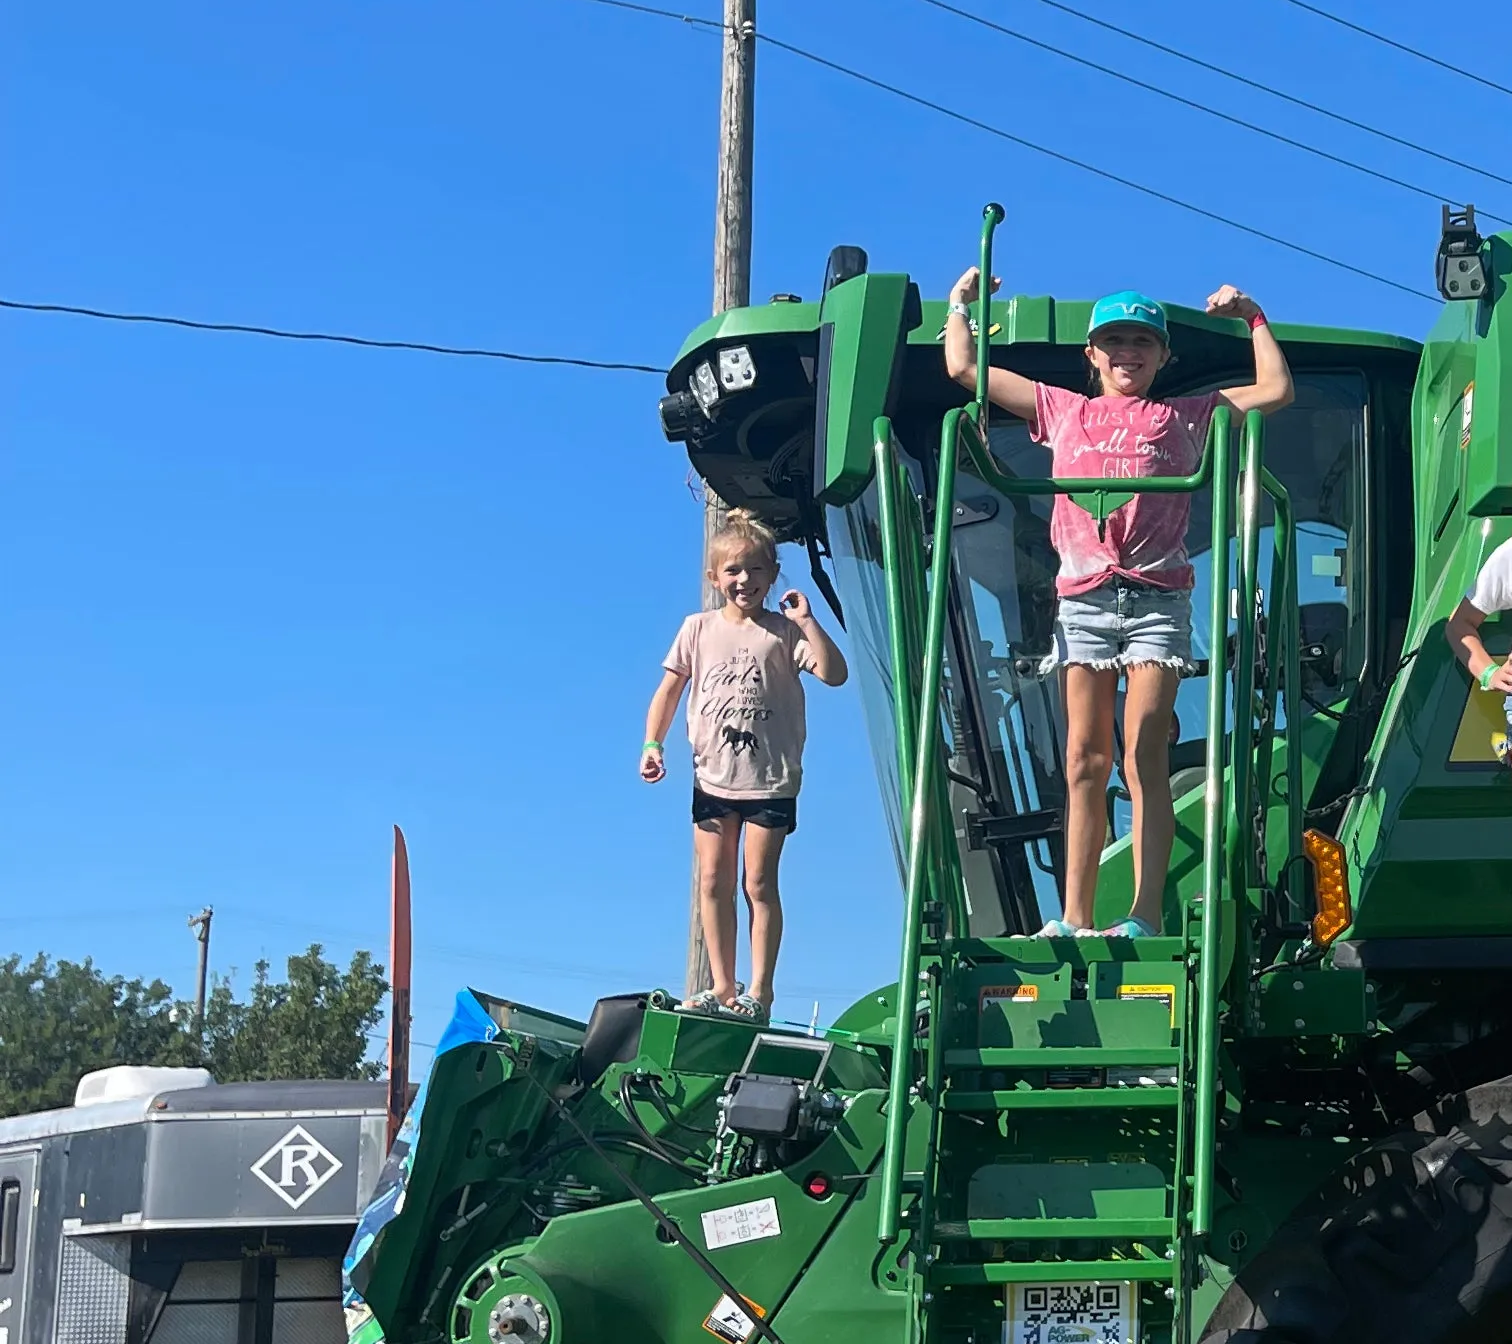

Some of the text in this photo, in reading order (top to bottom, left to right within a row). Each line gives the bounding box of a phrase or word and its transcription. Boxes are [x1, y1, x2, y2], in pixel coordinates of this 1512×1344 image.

[1083, 411, 1137, 429] JUST
[1134, 432, 1177, 466] town
[702, 662, 755, 696] Girl
[700, 696, 774, 724] Horses
[992, 987, 1035, 996] WARNING
[1047, 1333, 1090, 1344] POWER
